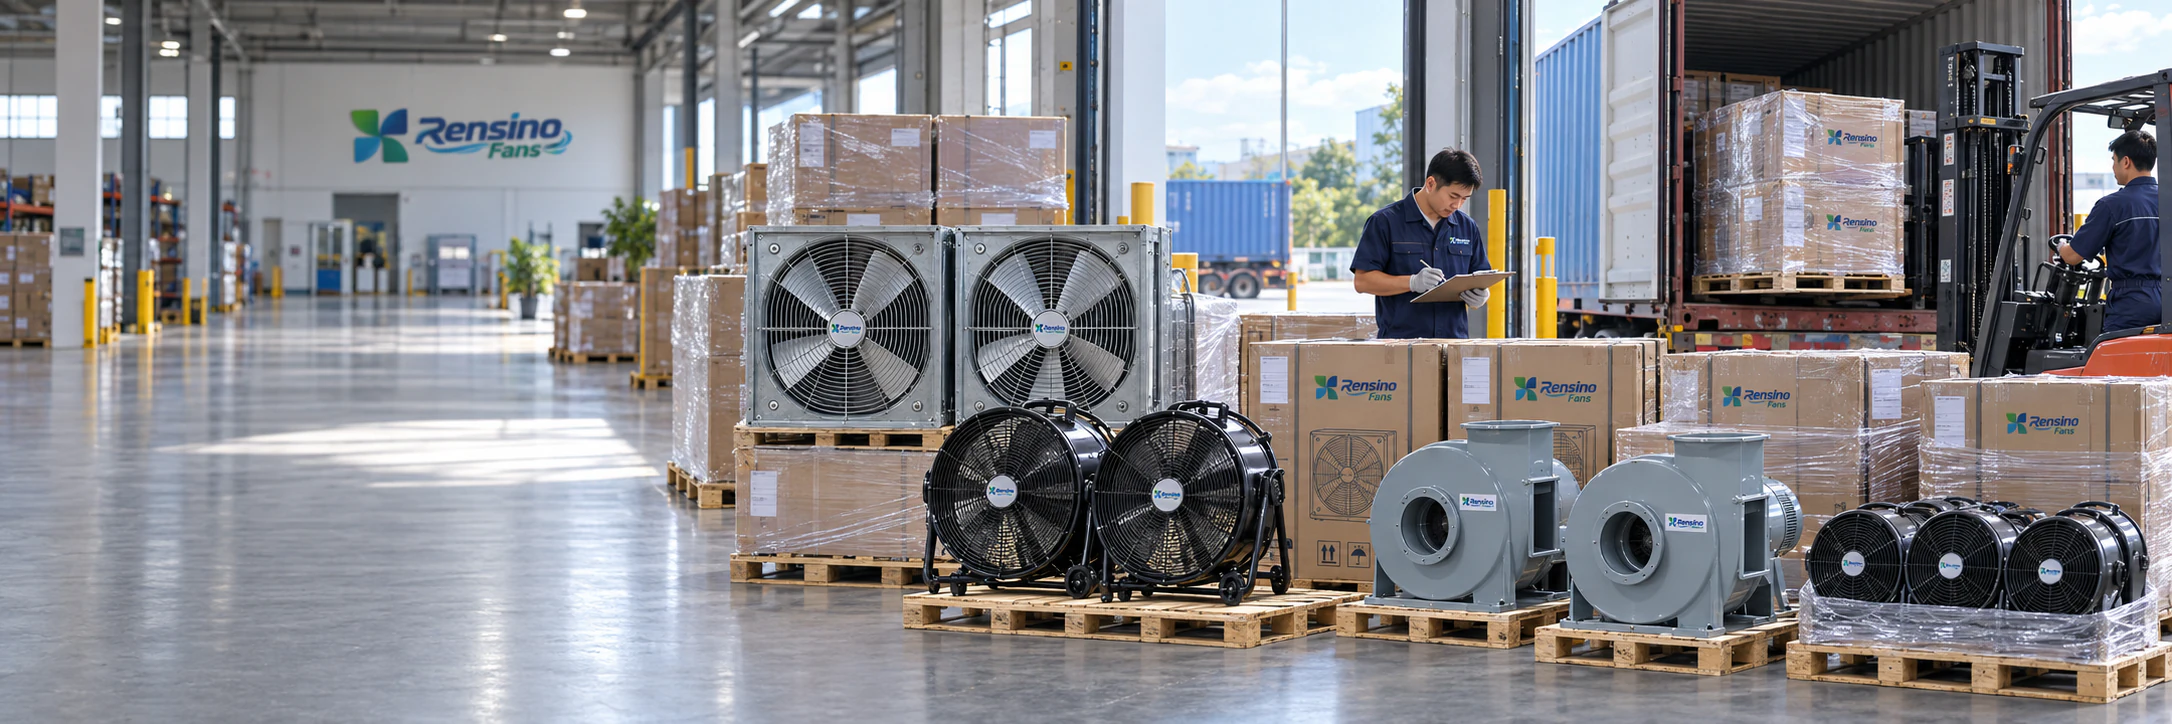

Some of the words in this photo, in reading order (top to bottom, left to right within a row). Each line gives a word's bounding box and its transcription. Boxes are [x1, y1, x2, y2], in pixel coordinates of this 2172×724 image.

[415, 112, 562, 145] Rensino
[488, 142, 541, 159] Fans
[1341, 379, 1397, 392] Rensino
[1540, 380, 1597, 393] Rensino
[1368, 391, 1393, 401] Fans
[1567, 393, 1592, 403] Fans
[1743, 389, 1791, 401] Rensino
[1767, 400, 1787, 408] Fans
[2029, 415, 2079, 428] Rensino
[2053, 426, 2075, 435] Fans
